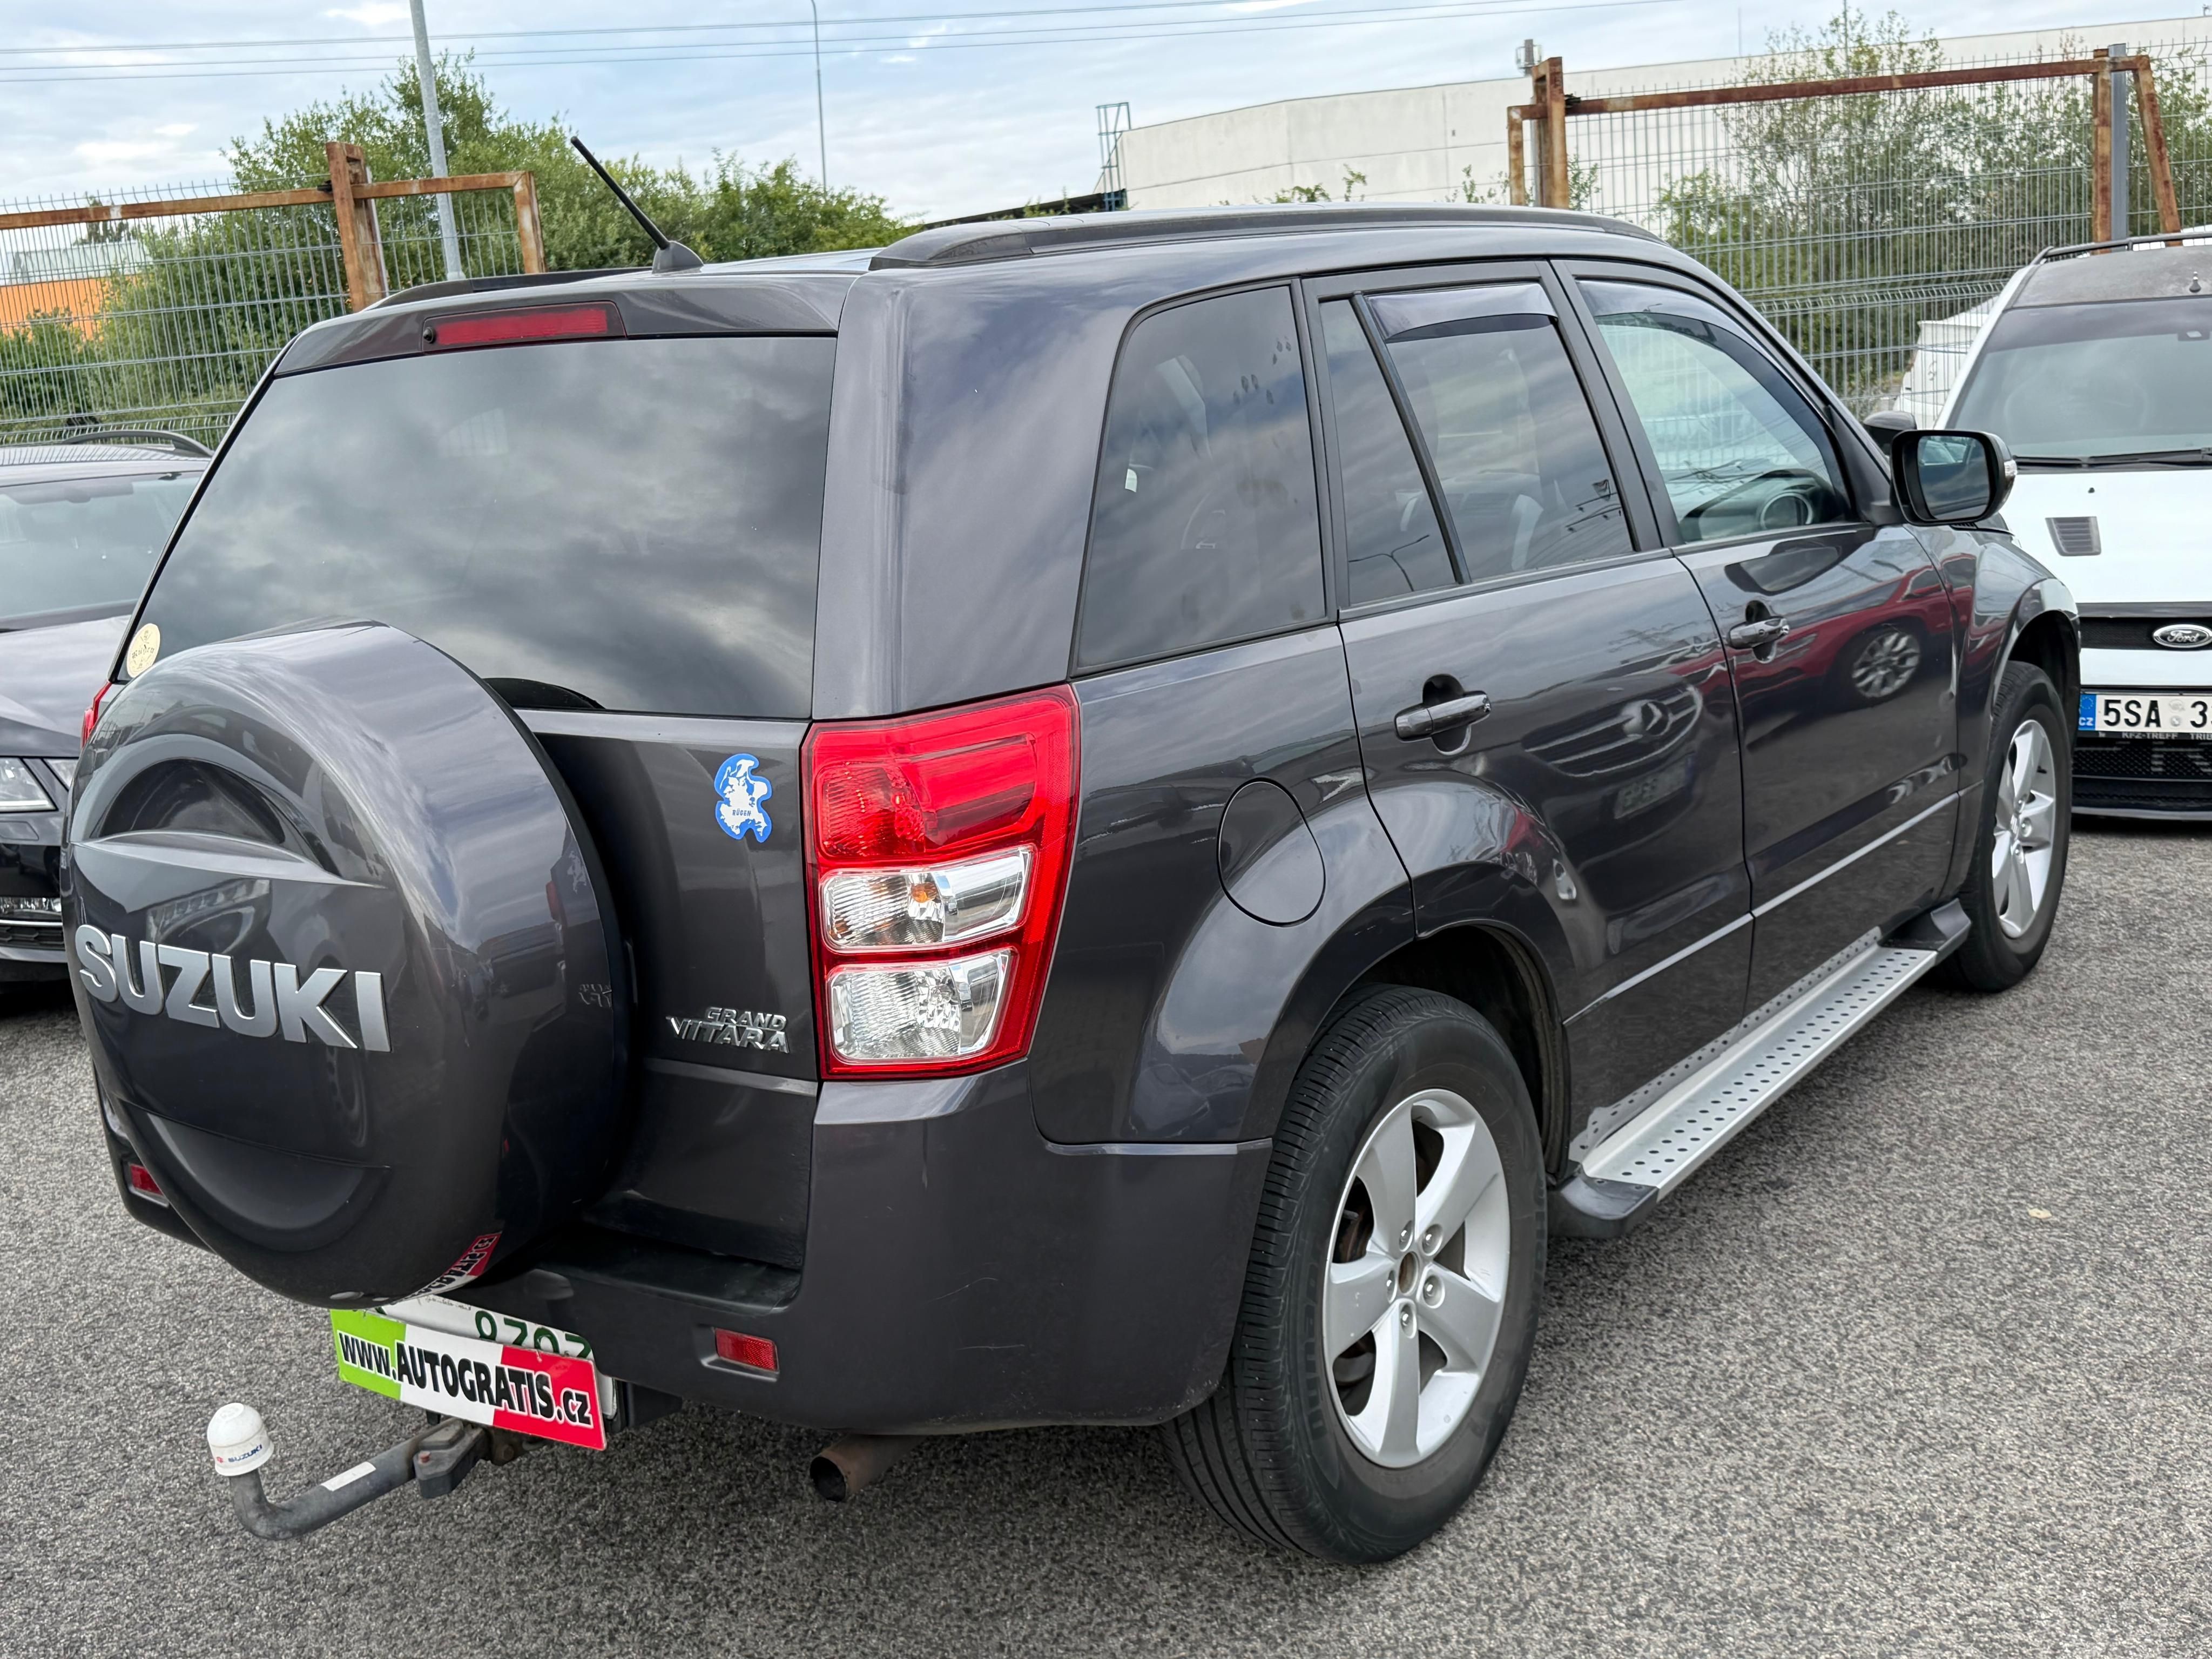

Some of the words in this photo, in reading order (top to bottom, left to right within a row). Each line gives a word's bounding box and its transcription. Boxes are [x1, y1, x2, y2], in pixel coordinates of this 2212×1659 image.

[2167, 630, 2200, 643] Ford
[2079, 717, 2093, 726] CZ
[2103, 699, 2162, 728] 5SA
[2190, 700, 2212, 729] 3
[2122, 732, 2178, 740] KFZ-TREFF
[732, 808, 751, 817] RÜGEN
[75, 924, 392, 1053] SUZUKI
[706, 1006, 787, 1031] GRAND
[665, 1015, 790, 1054] VITARA
[228, 1444, 262, 1462] SUZUKI
